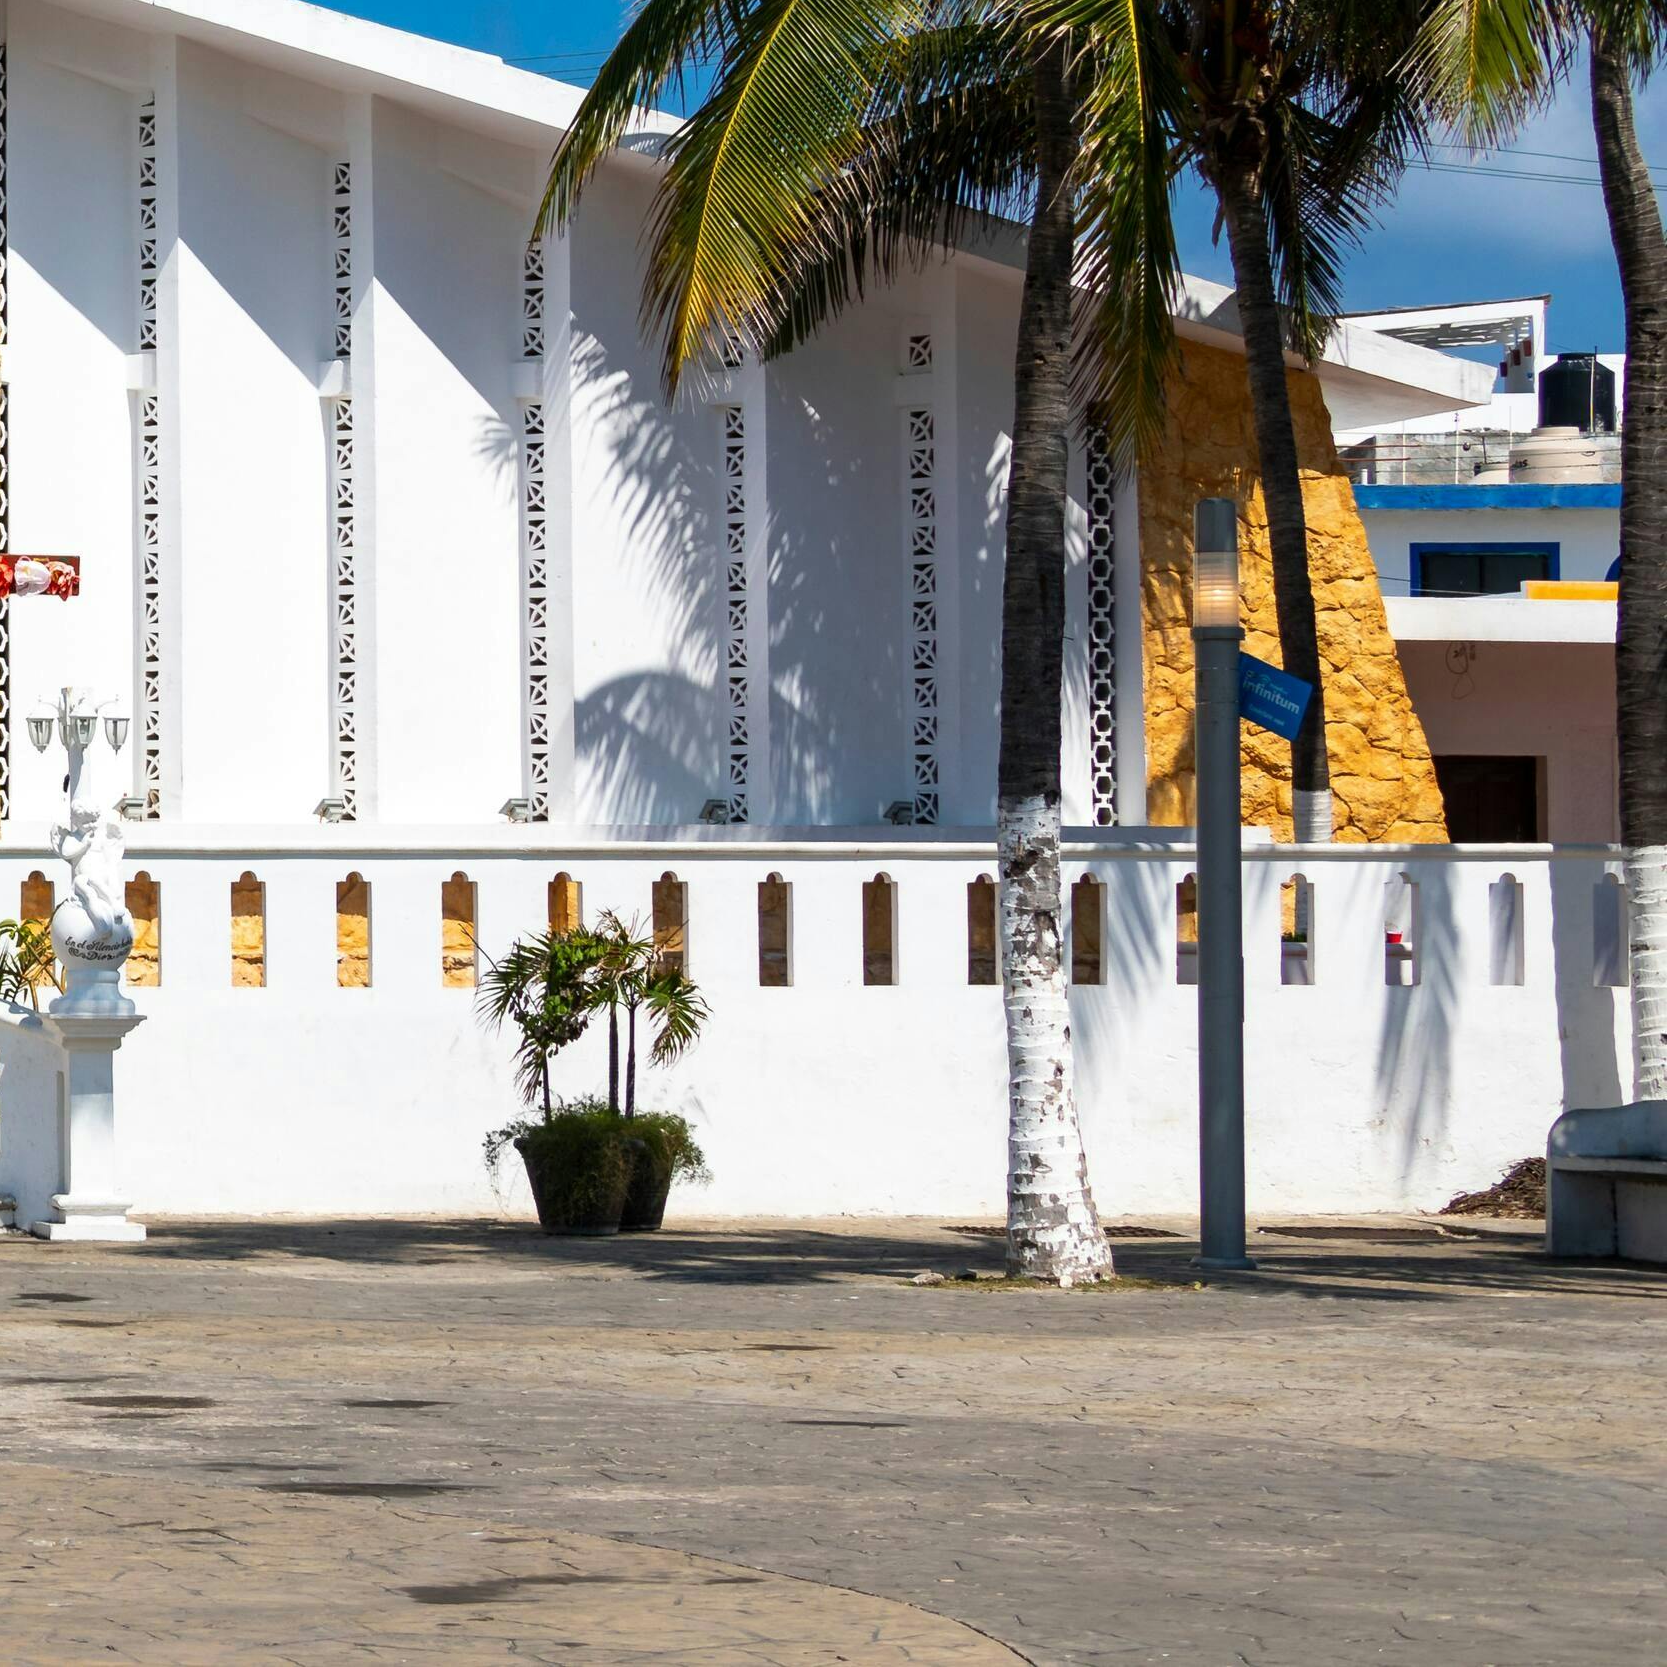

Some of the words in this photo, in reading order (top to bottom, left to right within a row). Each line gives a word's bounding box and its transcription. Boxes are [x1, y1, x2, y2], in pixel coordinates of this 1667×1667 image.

[1243, 677, 1300, 714] infinitum
[65, 936, 75, 946] En
[77, 940, 86, 948] el
